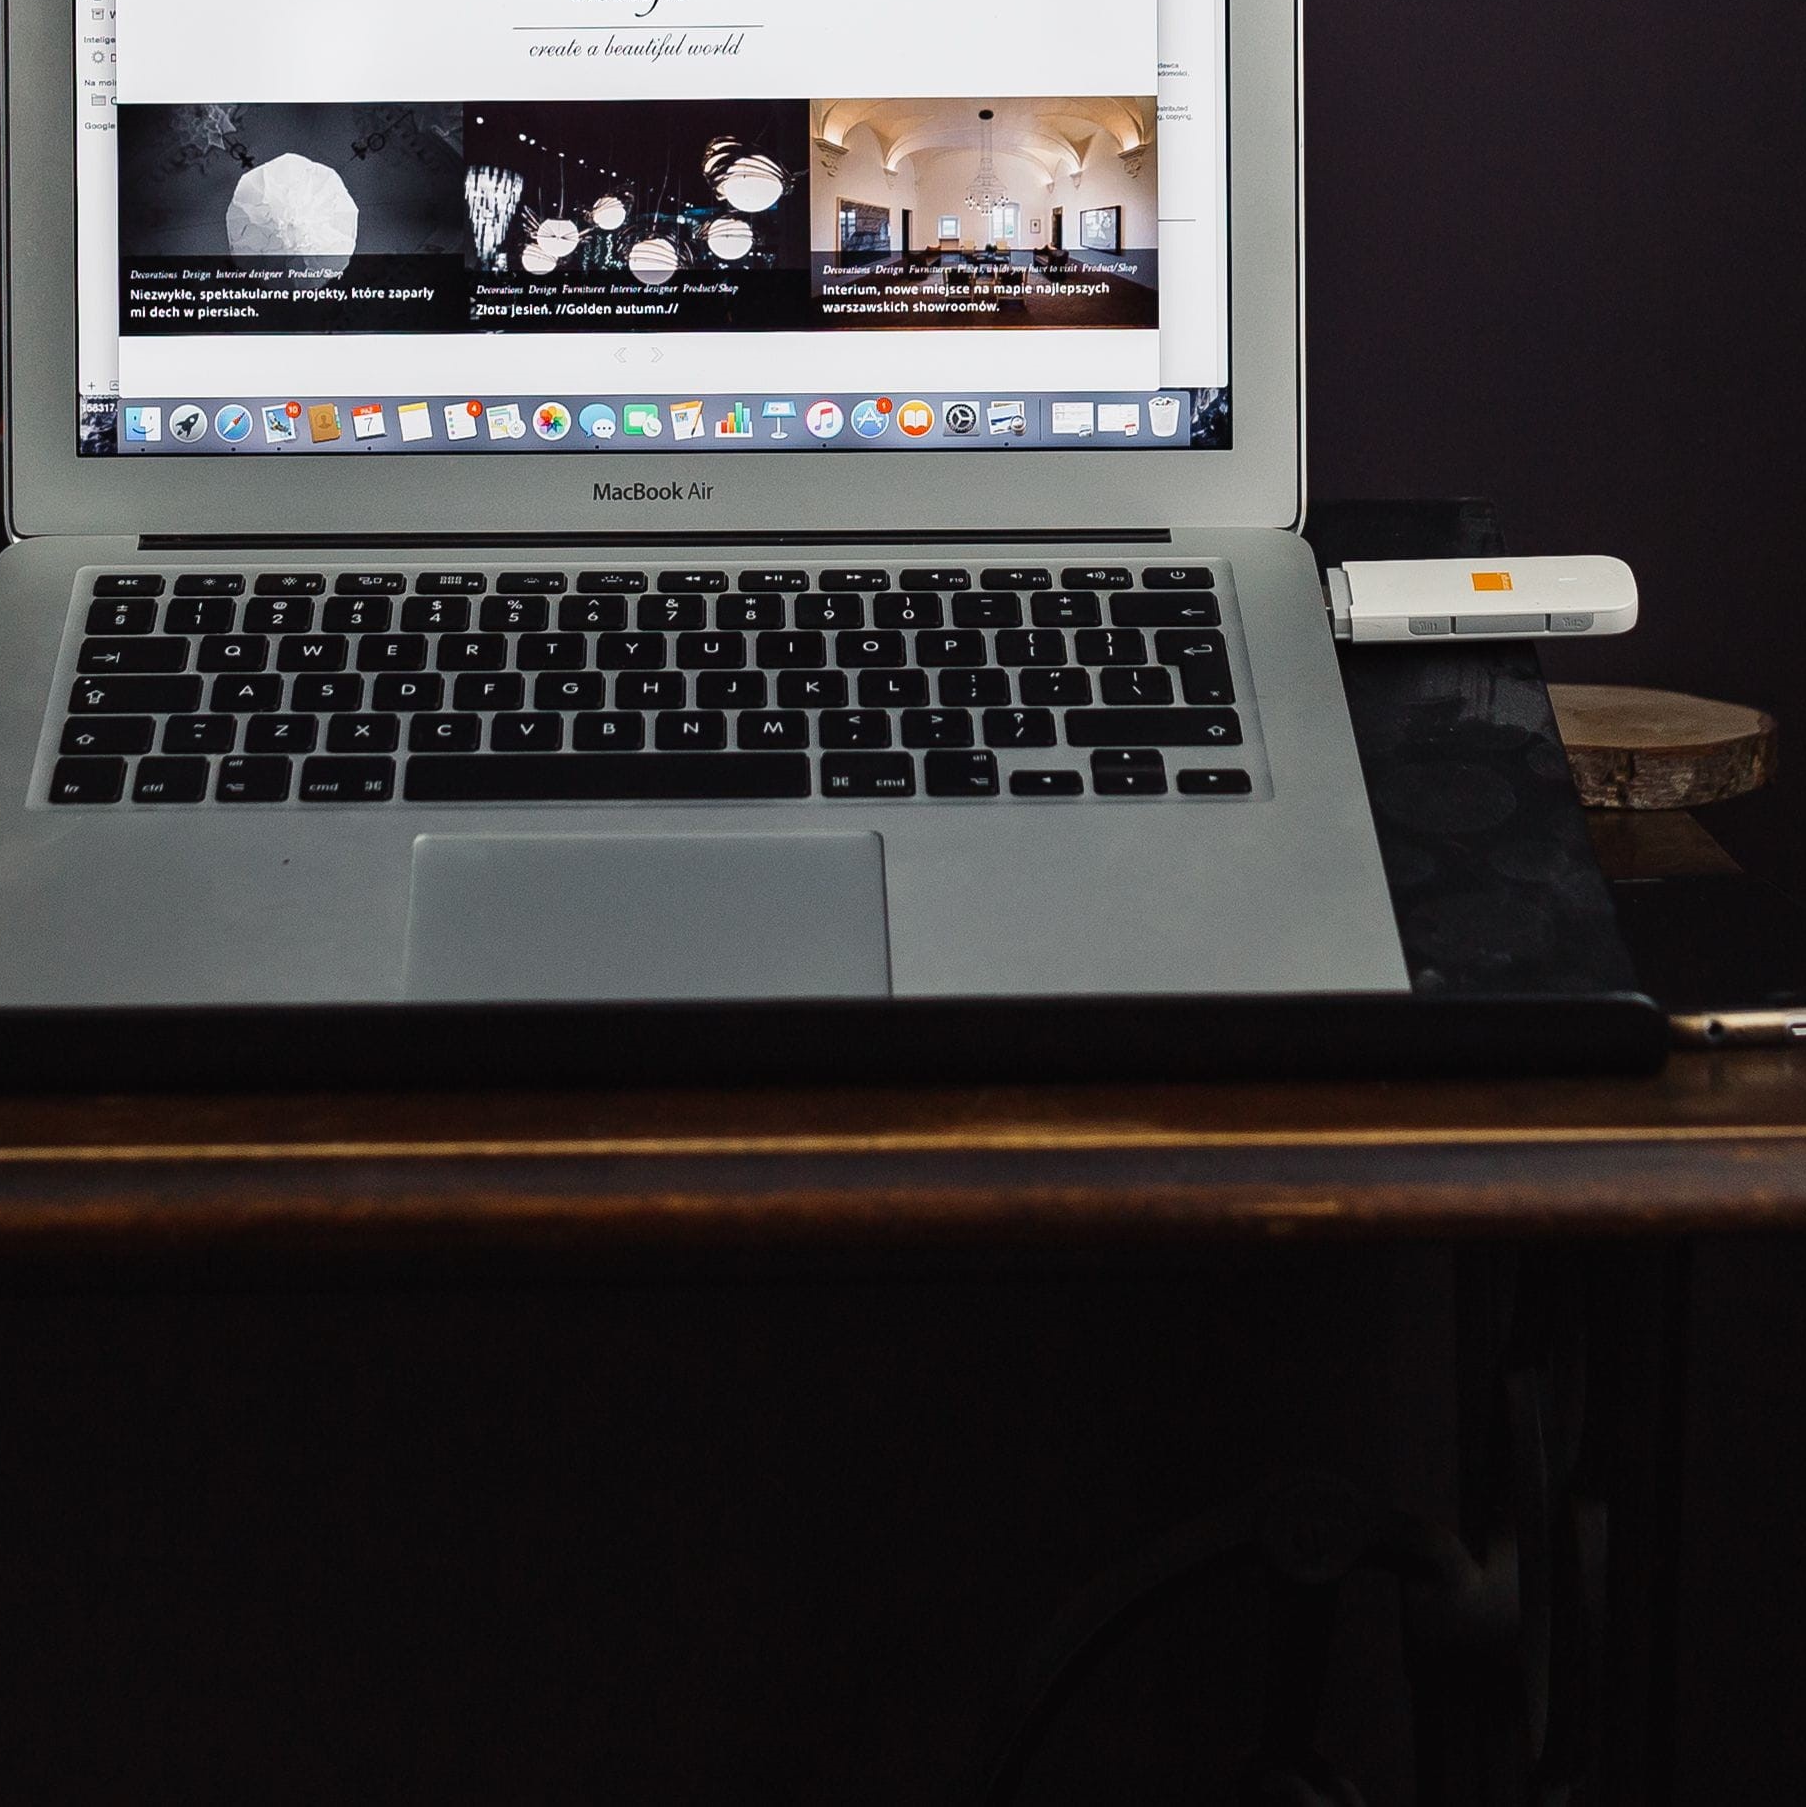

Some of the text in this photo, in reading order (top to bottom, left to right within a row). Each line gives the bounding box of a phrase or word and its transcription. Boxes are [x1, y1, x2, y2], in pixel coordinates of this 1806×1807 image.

[529, 33, 744, 63] create a beautiful world
[130, 268, 344, 281] Decorations Design Interior designer Product/Shop
[823, 265, 870, 275] Decorations
[875, 265, 904, 276] Design
[1050, 264, 1058, 274] to
[1082, 263, 1138, 276] Product/Shop
[130, 287, 434, 302] Niezwykłe, spektakularne projekty, które zaparły
[477, 285, 523, 294] Decorations
[528, 285, 557, 296] Design
[610, 284, 642, 294] Interior
[643, 284, 678, 295] designer
[683, 284, 739, 295] Product/Shop
[823, 283, 1110, 297] Interium, nowe miejsce na mapie najlepszych
[476, 303, 679, 318] Złota jesień. //Golden autumn.//
[823, 301, 1000, 313] warszawskich showroomów.
[130, 306, 259, 320] mi dech w piersiach.
[364, 417, 373, 432] 7
[593, 482, 714, 500] MacBook Air
[194, 615, 202, 624] 1
[272, 614, 284, 624] 2
[351, 614, 362, 623] 3
[429, 612, 441, 622] 4
[508, 612, 519, 622] 5
[588, 611, 598, 621] 6
[667, 611, 677, 621] 7
[745, 610, 756, 620] 8
[824, 610, 834, 619] 9
[303, 645, 323, 656] W
[387, 645, 397, 655] E
[466, 644, 478, 655] R
[547, 644, 558, 654] T
[626, 643, 638, 654] Y
[705, 643, 718, 653] U
[863, 640, 879, 652] O
[945, 640, 957, 651] P
[224, 646, 241, 657] Q
[239, 685, 254, 696] A
[321, 685, 334, 696] S
[401, 684, 416, 695] D
[485, 683, 495, 694] F
[563, 683, 578, 694] G
[644, 682, 658, 693] H
[727, 682, 736, 692] J
[806, 681, 819, 692] K
[889, 681, 900, 691] L
[274, 725, 289, 736] Z
[355, 725, 370, 736] X
[437, 724, 452, 735] C
[520, 723, 535, 735] V
[604, 723, 615, 734] B
[684, 722, 698, 733] N
[763, 722, 783, 733] M
[309, 782, 338, 792] cmd
[876, 778, 905, 787] cmd
